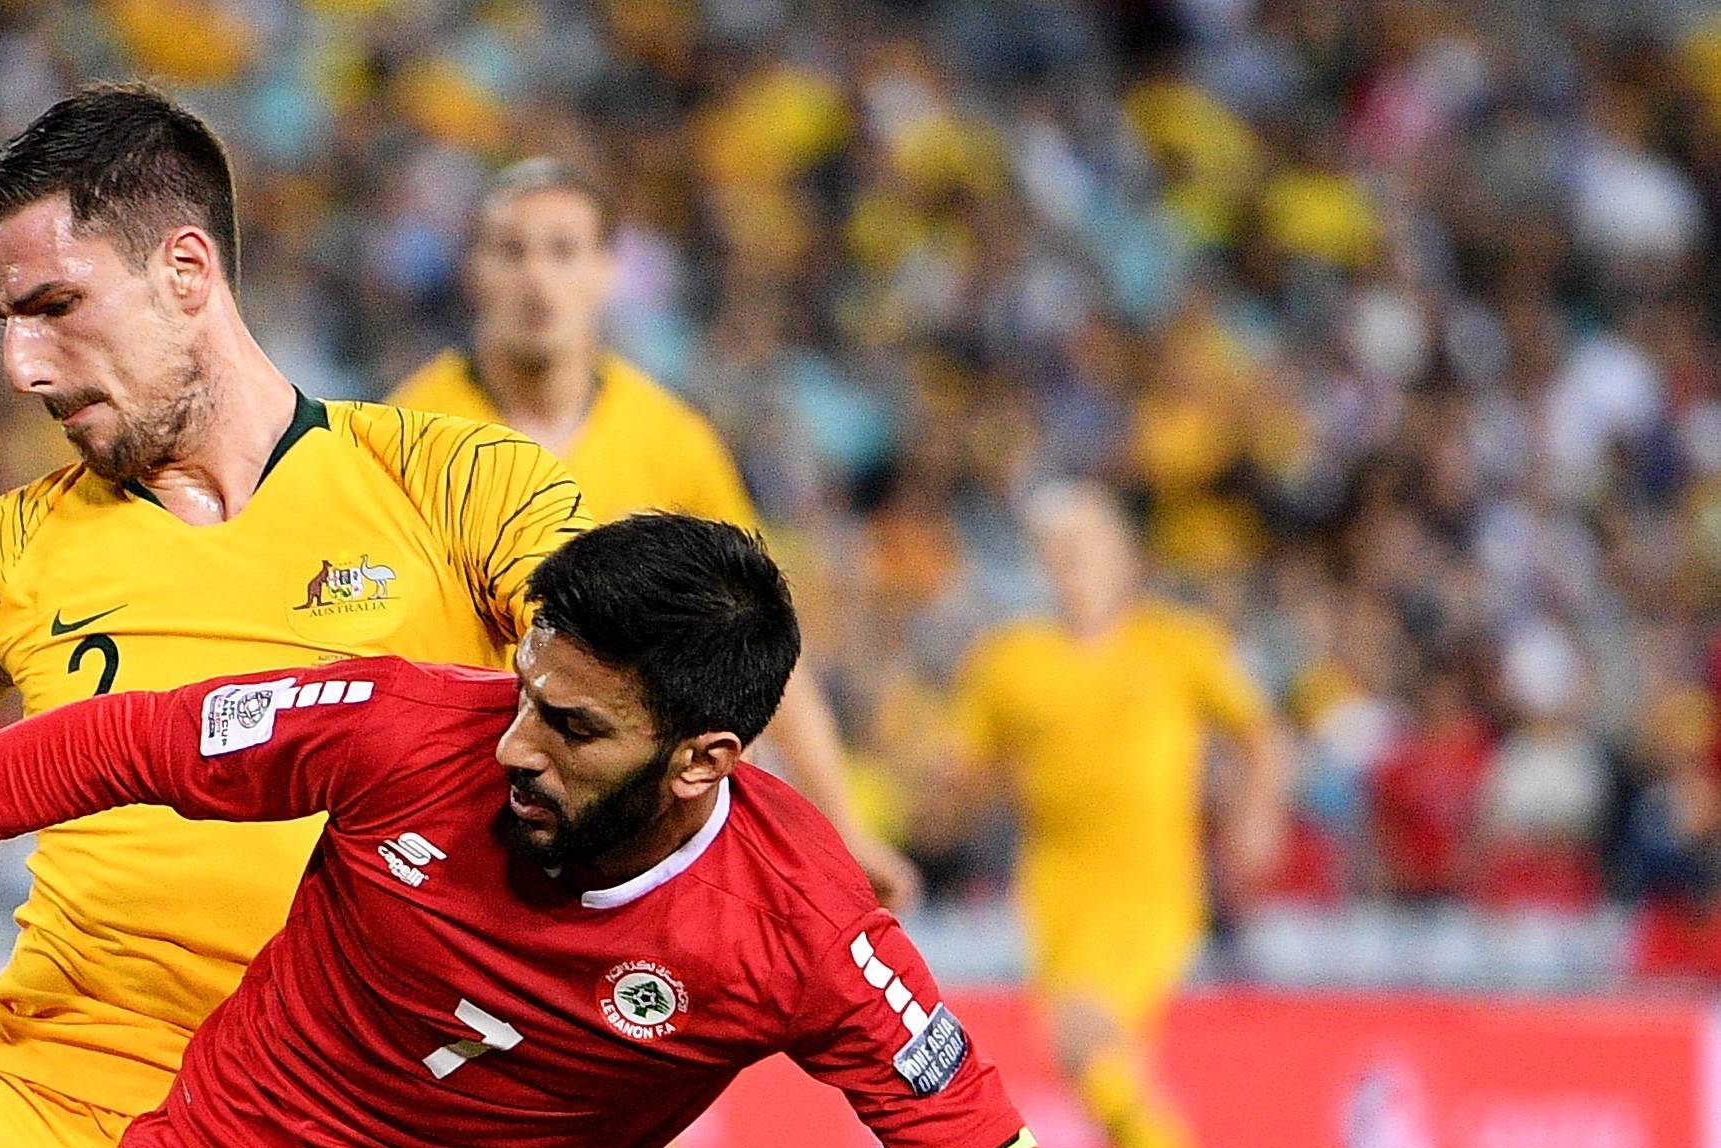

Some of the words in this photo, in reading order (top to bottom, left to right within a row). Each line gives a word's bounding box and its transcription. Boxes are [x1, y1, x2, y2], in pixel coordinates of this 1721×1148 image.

[309, 601, 386, 618] AUSTRALIA
[422, 998, 524, 1080] 7
[600, 999, 653, 1039] LEBANON
[905, 1044, 934, 1077] ONE
[927, 1017, 956, 1054] ASIA
[918, 1060, 944, 1093] ONE
